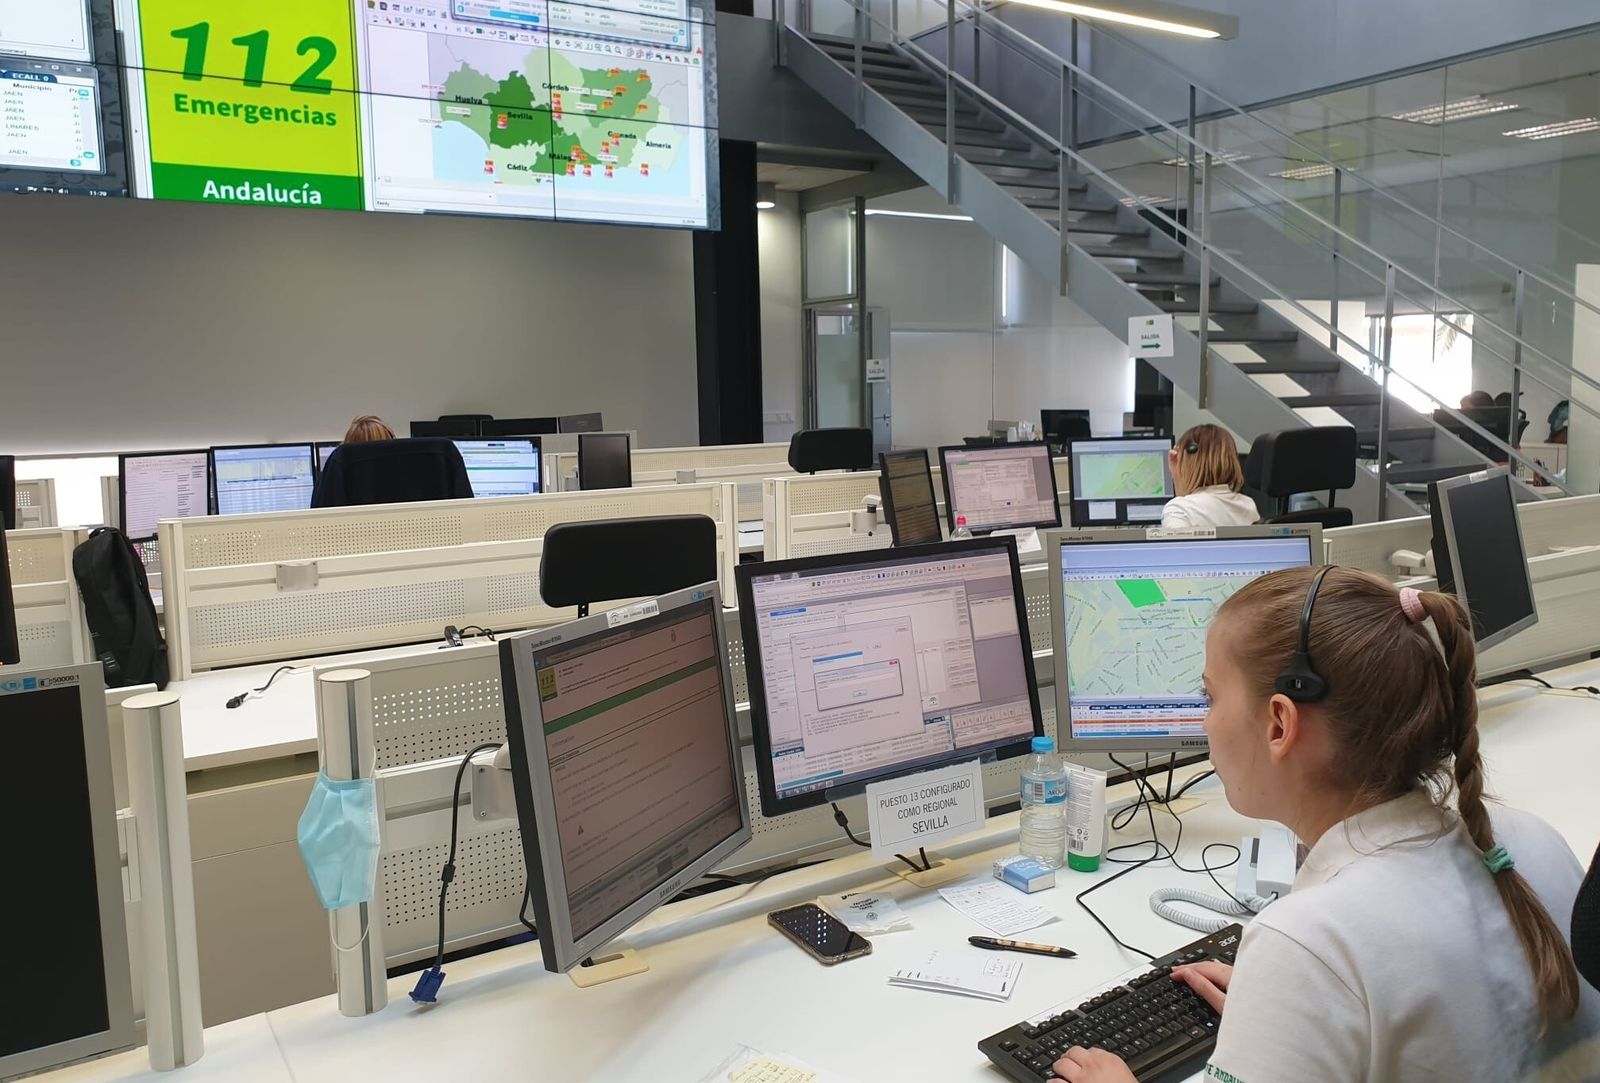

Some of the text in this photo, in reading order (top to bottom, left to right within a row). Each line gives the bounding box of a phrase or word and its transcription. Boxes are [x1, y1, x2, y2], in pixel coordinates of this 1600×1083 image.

[170, 22, 337, 95] 112
[12, 72, 41, 80] ECALL
[13, 82, 52, 91] Municipio
[541, 83, 569, 92] Córdob
[455, 95, 483, 105] Huelva
[174, 93, 337, 126] Emergencias
[507, 112, 533, 120] Sevilla
[607, 131, 637, 139] Gnada
[549, 153, 577, 162] Málag
[507, 163, 528, 171] Cádiz
[203, 180, 322, 205] Andalucía
[880, 779, 971, 808] PUESTO 13 CONFIGURADO
[897, 797, 958, 819] COMO REGIONAL
[912, 815, 949, 834] SEVILLA
[1218, 935, 1238, 947] acer
